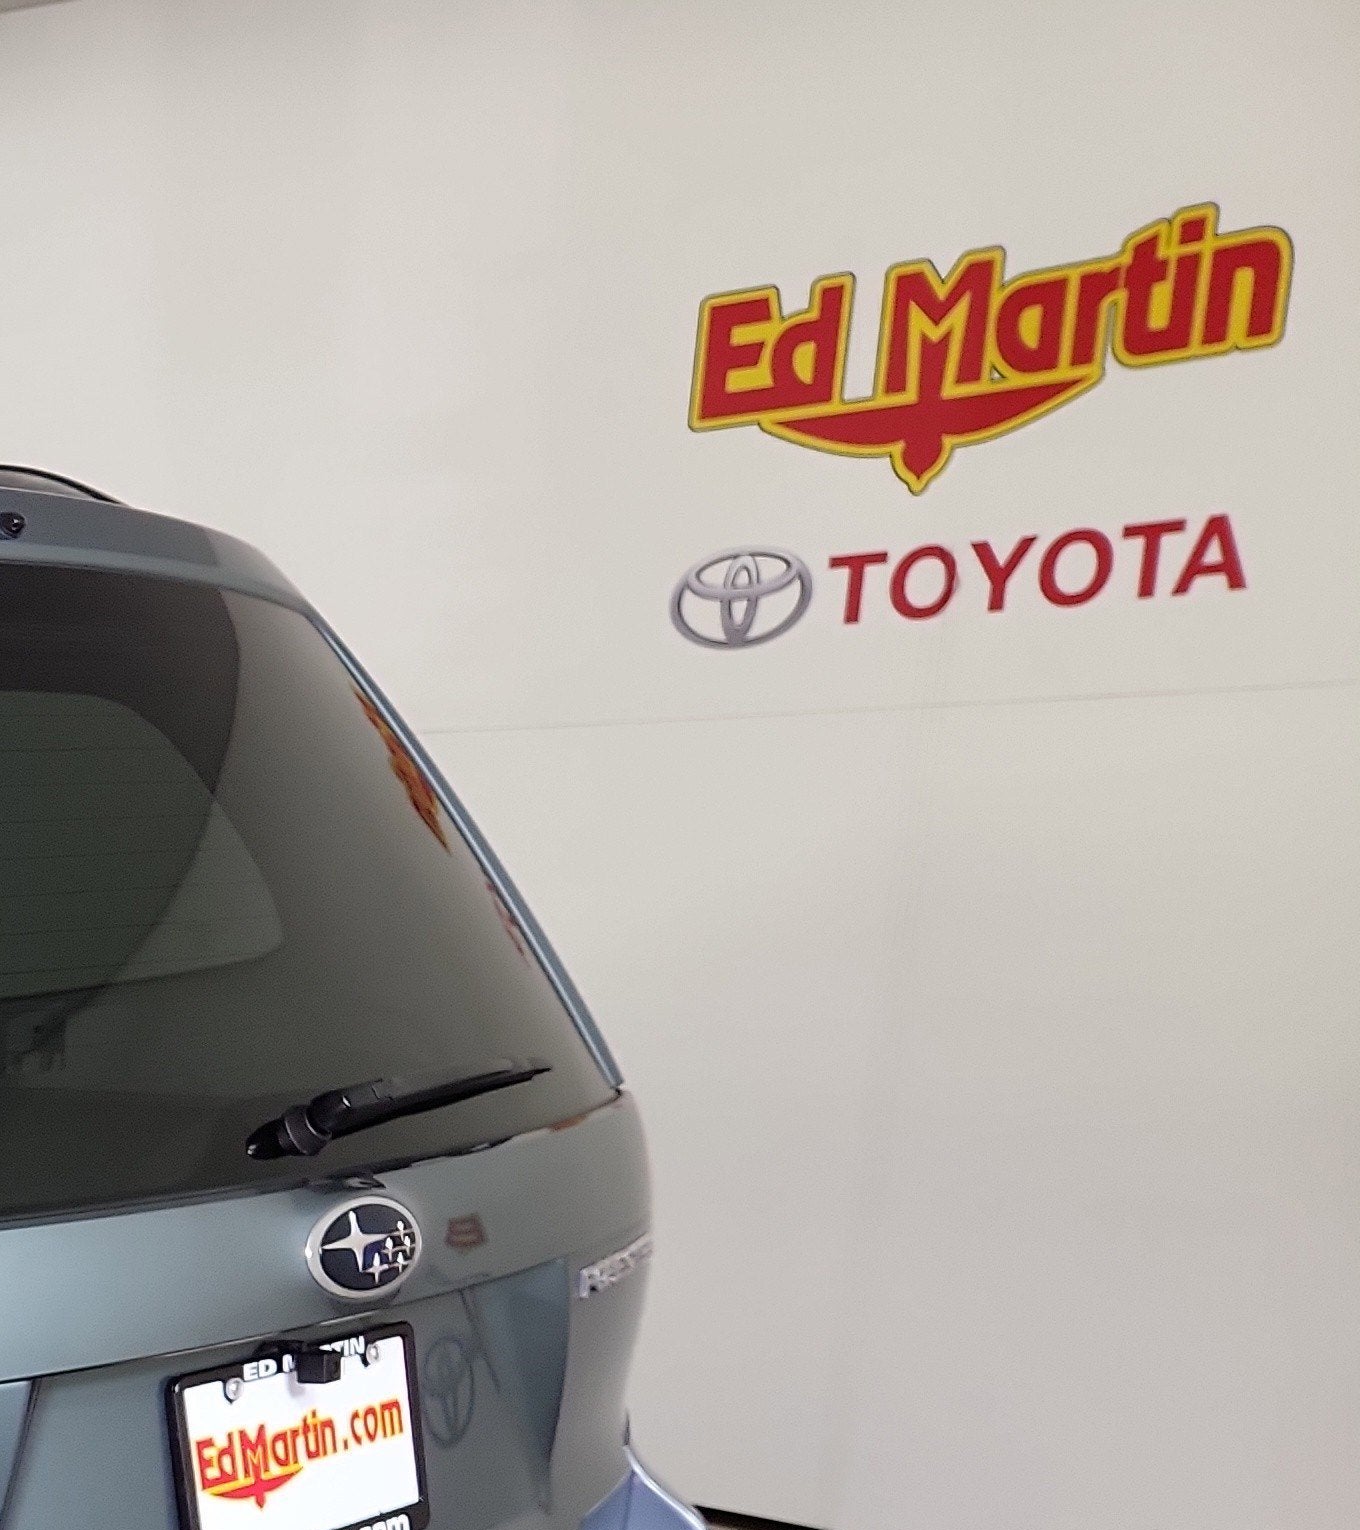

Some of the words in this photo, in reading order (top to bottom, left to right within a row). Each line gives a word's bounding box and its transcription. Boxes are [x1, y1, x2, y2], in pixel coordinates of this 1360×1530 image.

[691, 275, 853, 428] Ed
[877, 205, 1291, 394] Martin
[828, 513, 1249, 626] TOYOTA
[242, 1358, 278, 1382] ED
[194, 1399, 404, 1492] EdMartin.com
